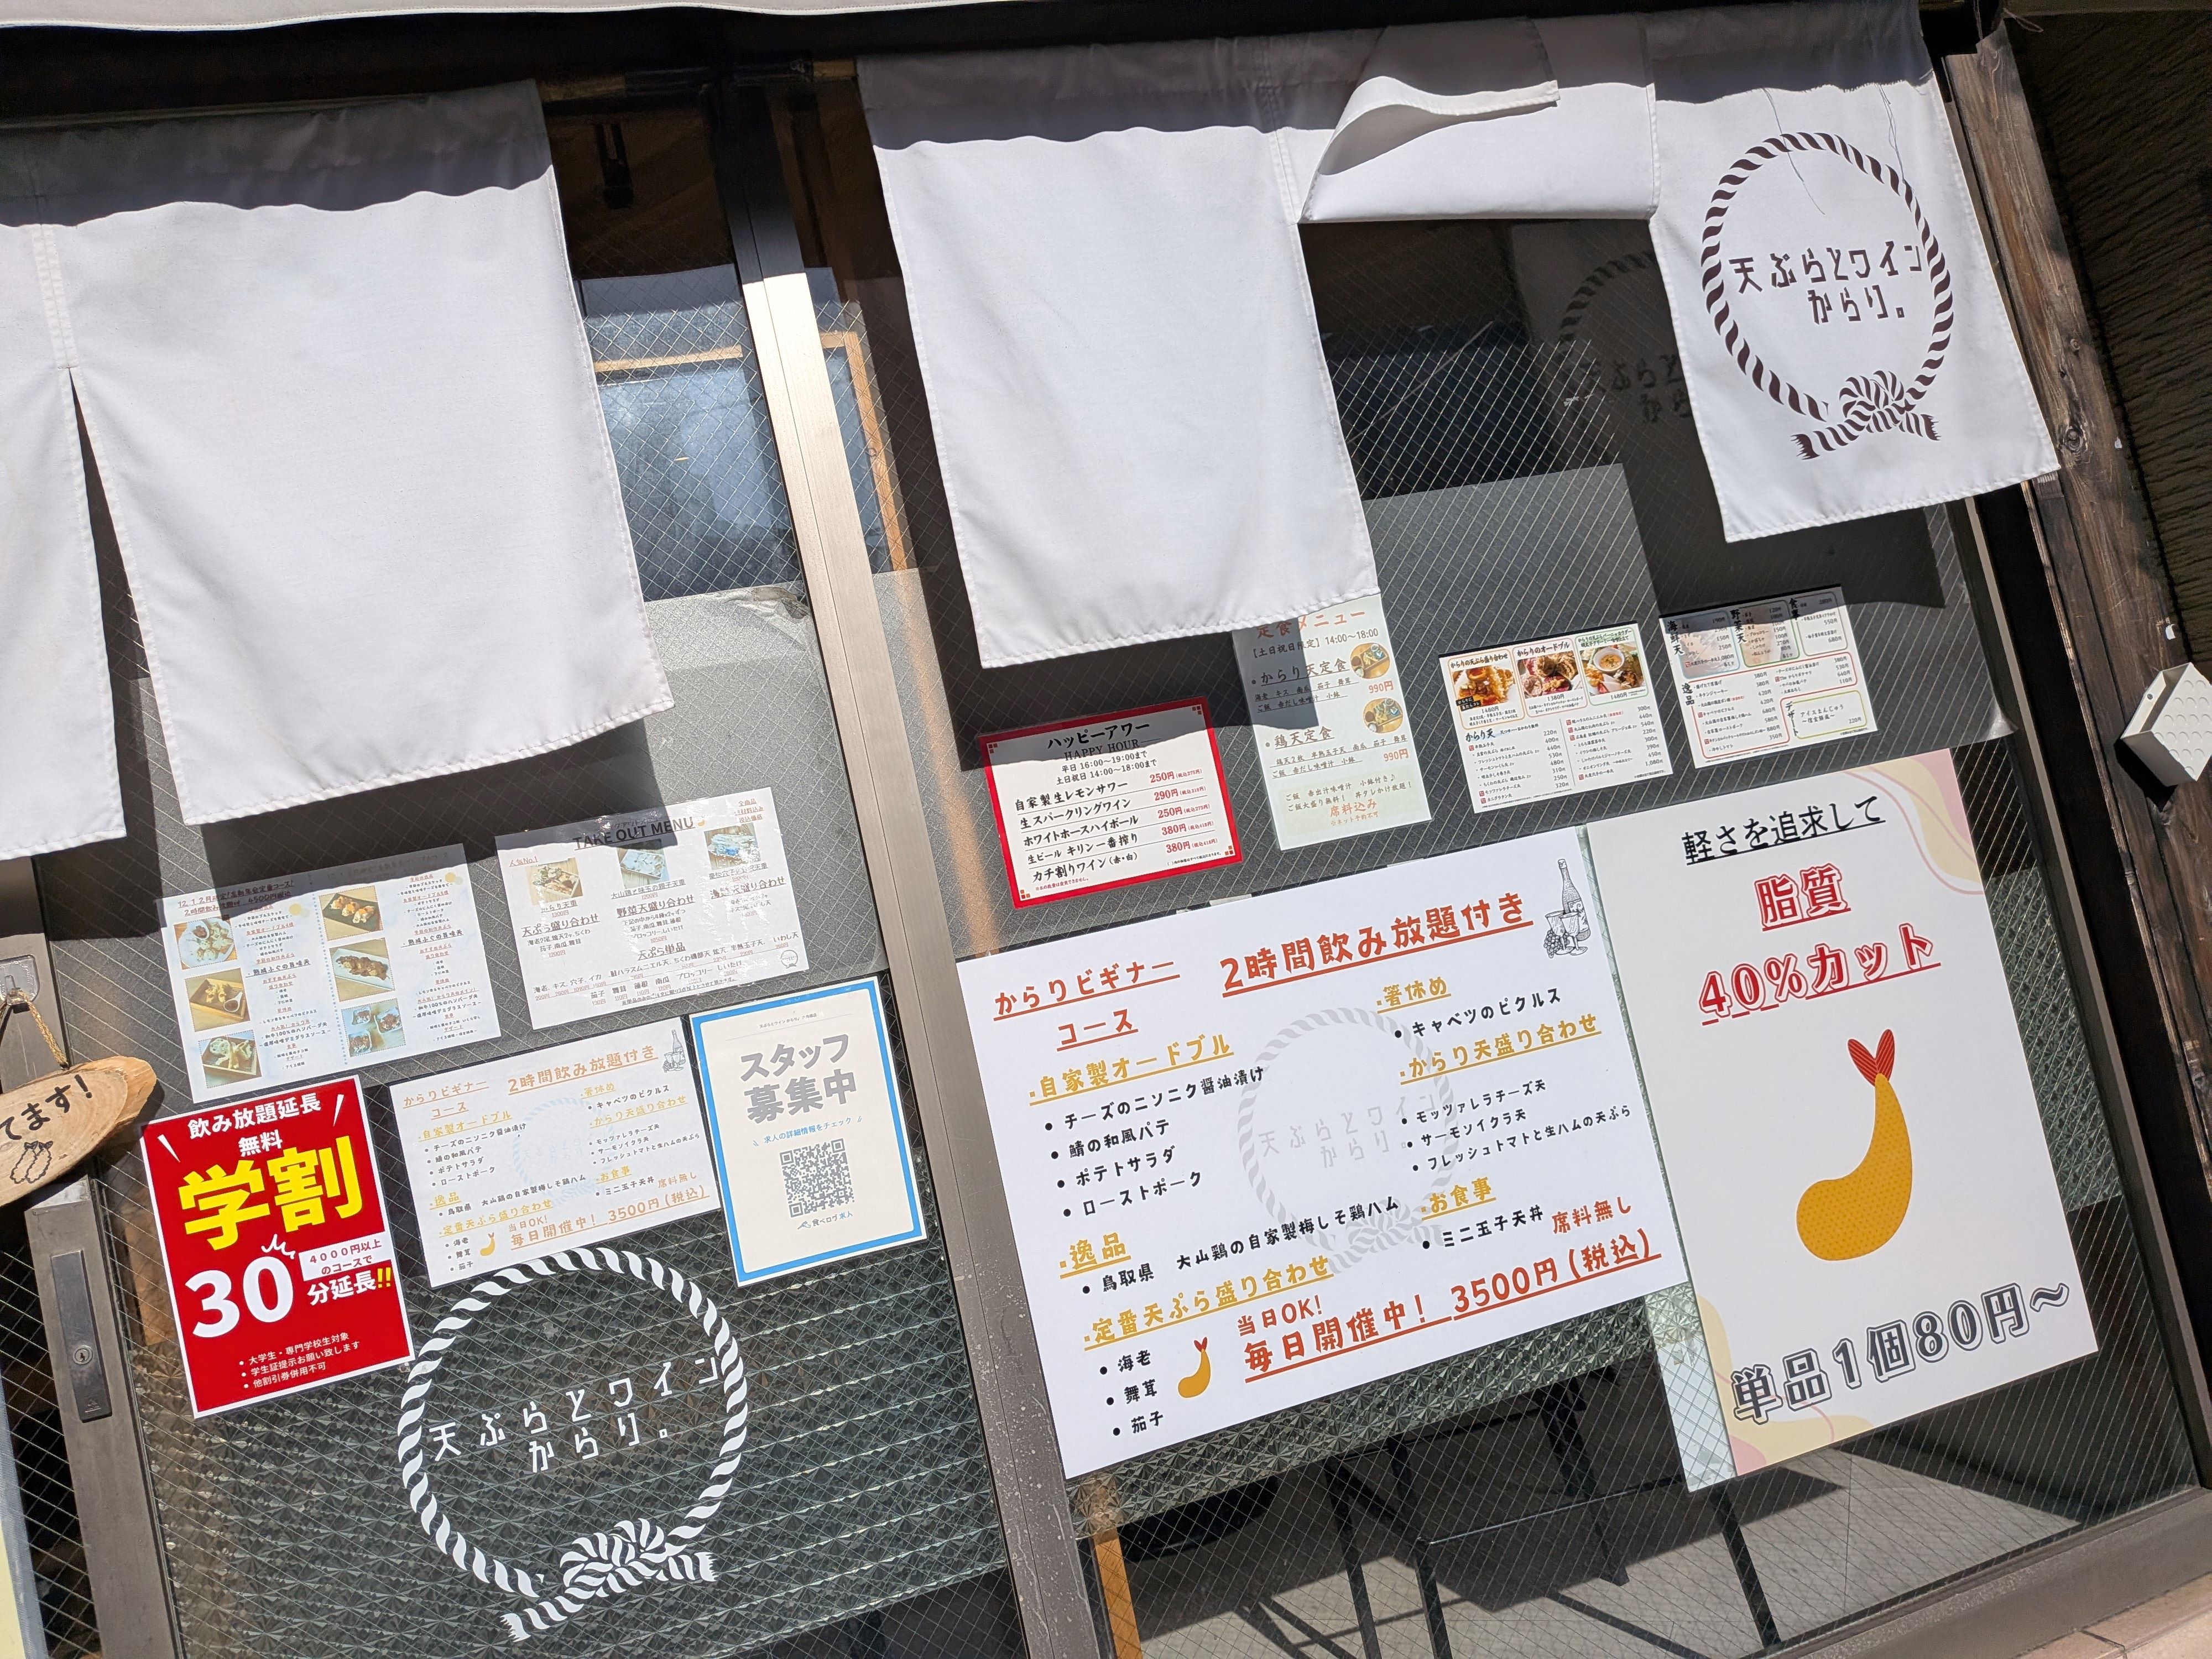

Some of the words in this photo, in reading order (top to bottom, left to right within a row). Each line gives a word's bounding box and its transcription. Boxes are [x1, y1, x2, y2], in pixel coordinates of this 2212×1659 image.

[1729, 241, 1921, 295] 天ぷらとワイン
[1261, 658, 1347, 686] からり天定食
[1275, 688, 1289, 698] キス
[1368, 680, 1394, 693] 990円
[1047, 722, 1150, 749] ハッピーアワー
[1274, 724, 1332, 750] 鶏天定食
[1465, 728, 1495, 742] からり天
[1063, 745, 1102, 761] HAPPY
[1107, 738, 1139, 753] HOUR
[1383, 748, 1408, 762] 990円
[1056, 771, 1087, 785] 土日祝日
[1061, 763, 1077, 773] 平日
[1330, 798, 1377, 817] 席料込み
[615, 825, 646, 841] OUT
[650, 816, 693, 835] MENU
[1023, 815, 1139, 846] ホワイトホースハイボール
[1682, 796, 1882, 860] 軽さを追求して
[1027, 849, 1062, 865] 生ビール
[617, 894, 694, 917] 野菜天盛り合わせ
[1754, 863, 1847, 925] 脂質
[637, 941, 686, 961] 天ぷら単品
[1221, 894, 1521, 989] 2時間飲み放題付き
[1699, 924, 1937, 1016] 40%カット
[995, 961, 1176, 1015] からりビギナー
[1412, 988, 1560, 1036] キャベツのピクルス
[1058, 1008, 1132, 1045] コース
[508, 1045, 656, 1092] 2時間飲み放題付き
[740, 1034, 848, 1081] スタッフ
[403, 1081, 488, 1107] からりビギナー
[596, 1084, 669, 1108] キャベツのピクルス
[744, 1068, 856, 1123] 募集中
[1416, 1079, 1546, 1123] モッツァレラチーズ天
[188, 1092, 320, 1138] 飲み放題延長
[431, 1101, 468, 1118] コース
[238, 1129, 283, 1157] 無料
[764, 1117, 851, 1143] 求人の詳細情報をチェック
[1069, 1119, 1168, 1157] 鯖の和風パテ
[1427, 1105, 1630, 1170] フレッシュトマトと生ハムの天ぷら
[435, 1145, 482, 1163] 鯖の和風パテ
[437, 1156, 484, 1174] ポテトサラダ
[1076, 1145, 1175, 1186] ポテトサラダ
[440, 1166, 495, 1186] ローストポーク
[605, 1175, 654, 1195] ミニ玉子天丼
[658, 1171, 697, 1188] 席料無し
[179, 1136, 361, 1248] 学割
[1083, 1171, 1201, 1215] ローストポーク
[447, 1202, 472, 1215] 鳥取県
[1552, 1197, 1631, 1233] 席料無し
[1442, 1205, 1543, 1247] ミニ玉子天丼
[308, 1237, 382, 1264] 4000円以上
[452, 1237, 468, 1246] 海老
[455, 1248, 471, 1259] 舞茸
[1102, 1262, 1154, 1292] 鳥取県
[1177, 1196, 1397, 1269] 大山鶏の自家製梅しそ鶏ハム
[319, 1254, 373, 1275] のコースで
[458, 1260, 473, 1270] 茄子
[186, 1253, 293, 1337] 30
[1238, 1295, 1322, 1336] 当日OK!
[1245, 1296, 1425, 1370] 毎日開催中!
[249, 1332, 349, 1365] 大学生・専門学校生対象
[251, 1340, 359, 1376] 学生証提示お願い致します
[1117, 1349, 1151, 1372] 海老
[1731, 1283, 2068, 1421] 単品1個80円〜
[253, 1361, 326, 1388] 他割引券併用不可
[1124, 1378, 1157, 1404] 舞茸
[429, 1357, 717, 1460] 天ぷらとワイン
[1130, 1410, 1163, 1433] 茄子
